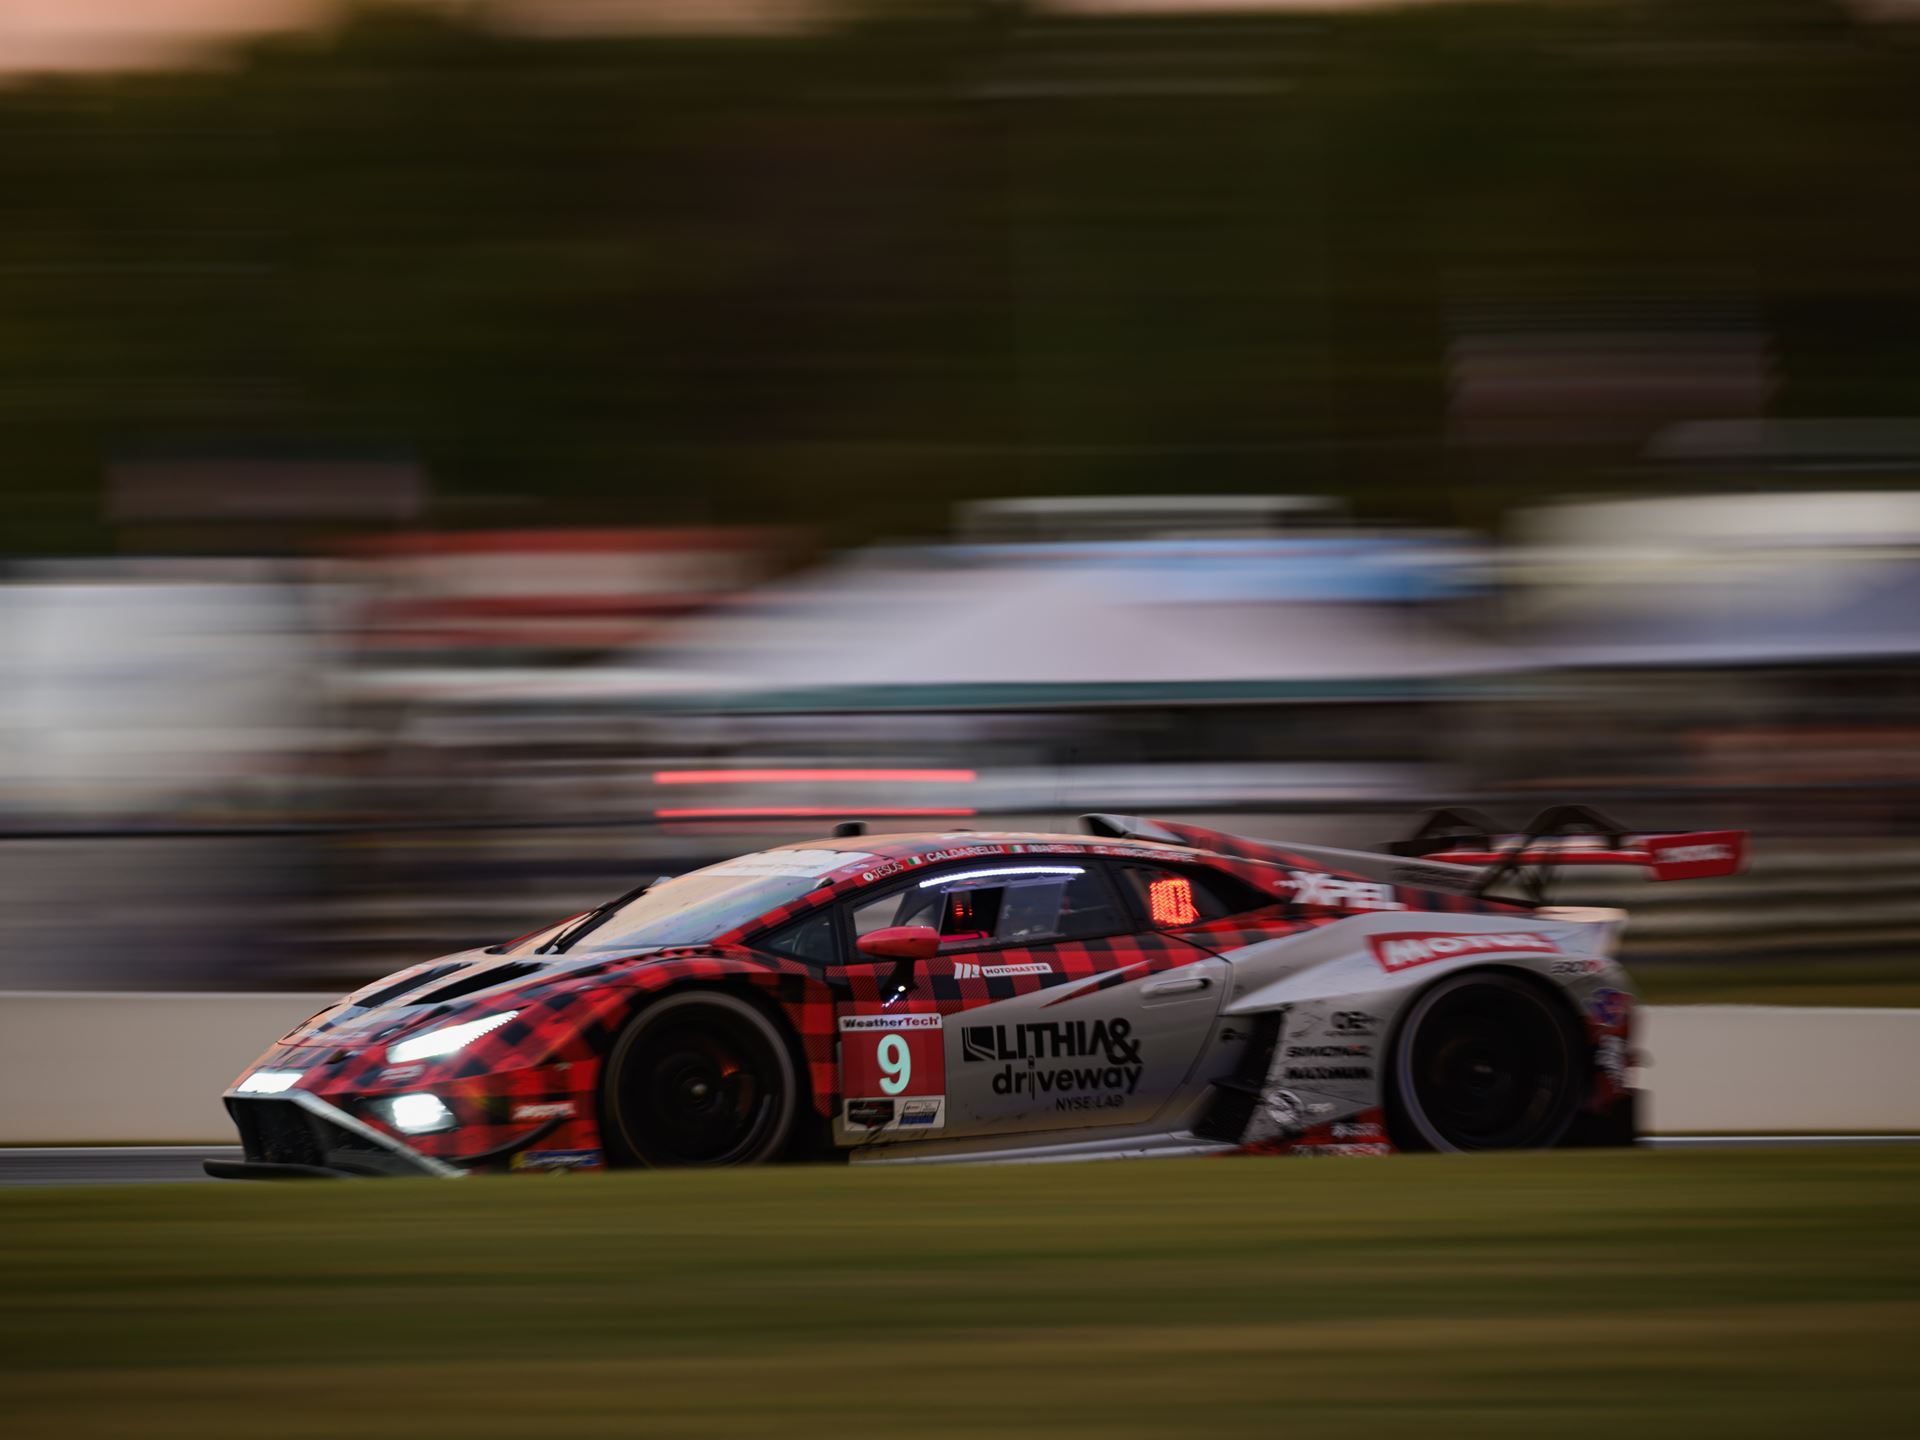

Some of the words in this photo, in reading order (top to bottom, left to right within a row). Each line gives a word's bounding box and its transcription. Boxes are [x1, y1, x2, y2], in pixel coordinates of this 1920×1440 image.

[926, 845, 1003, 863] CALDARELLI
[1382, 933, 1553, 968] MOTUL
[985, 965, 1050, 975] MOTOMASTER
[876, 1033, 912, 1096] 9
[991, 1063, 1144, 1101] driveway
